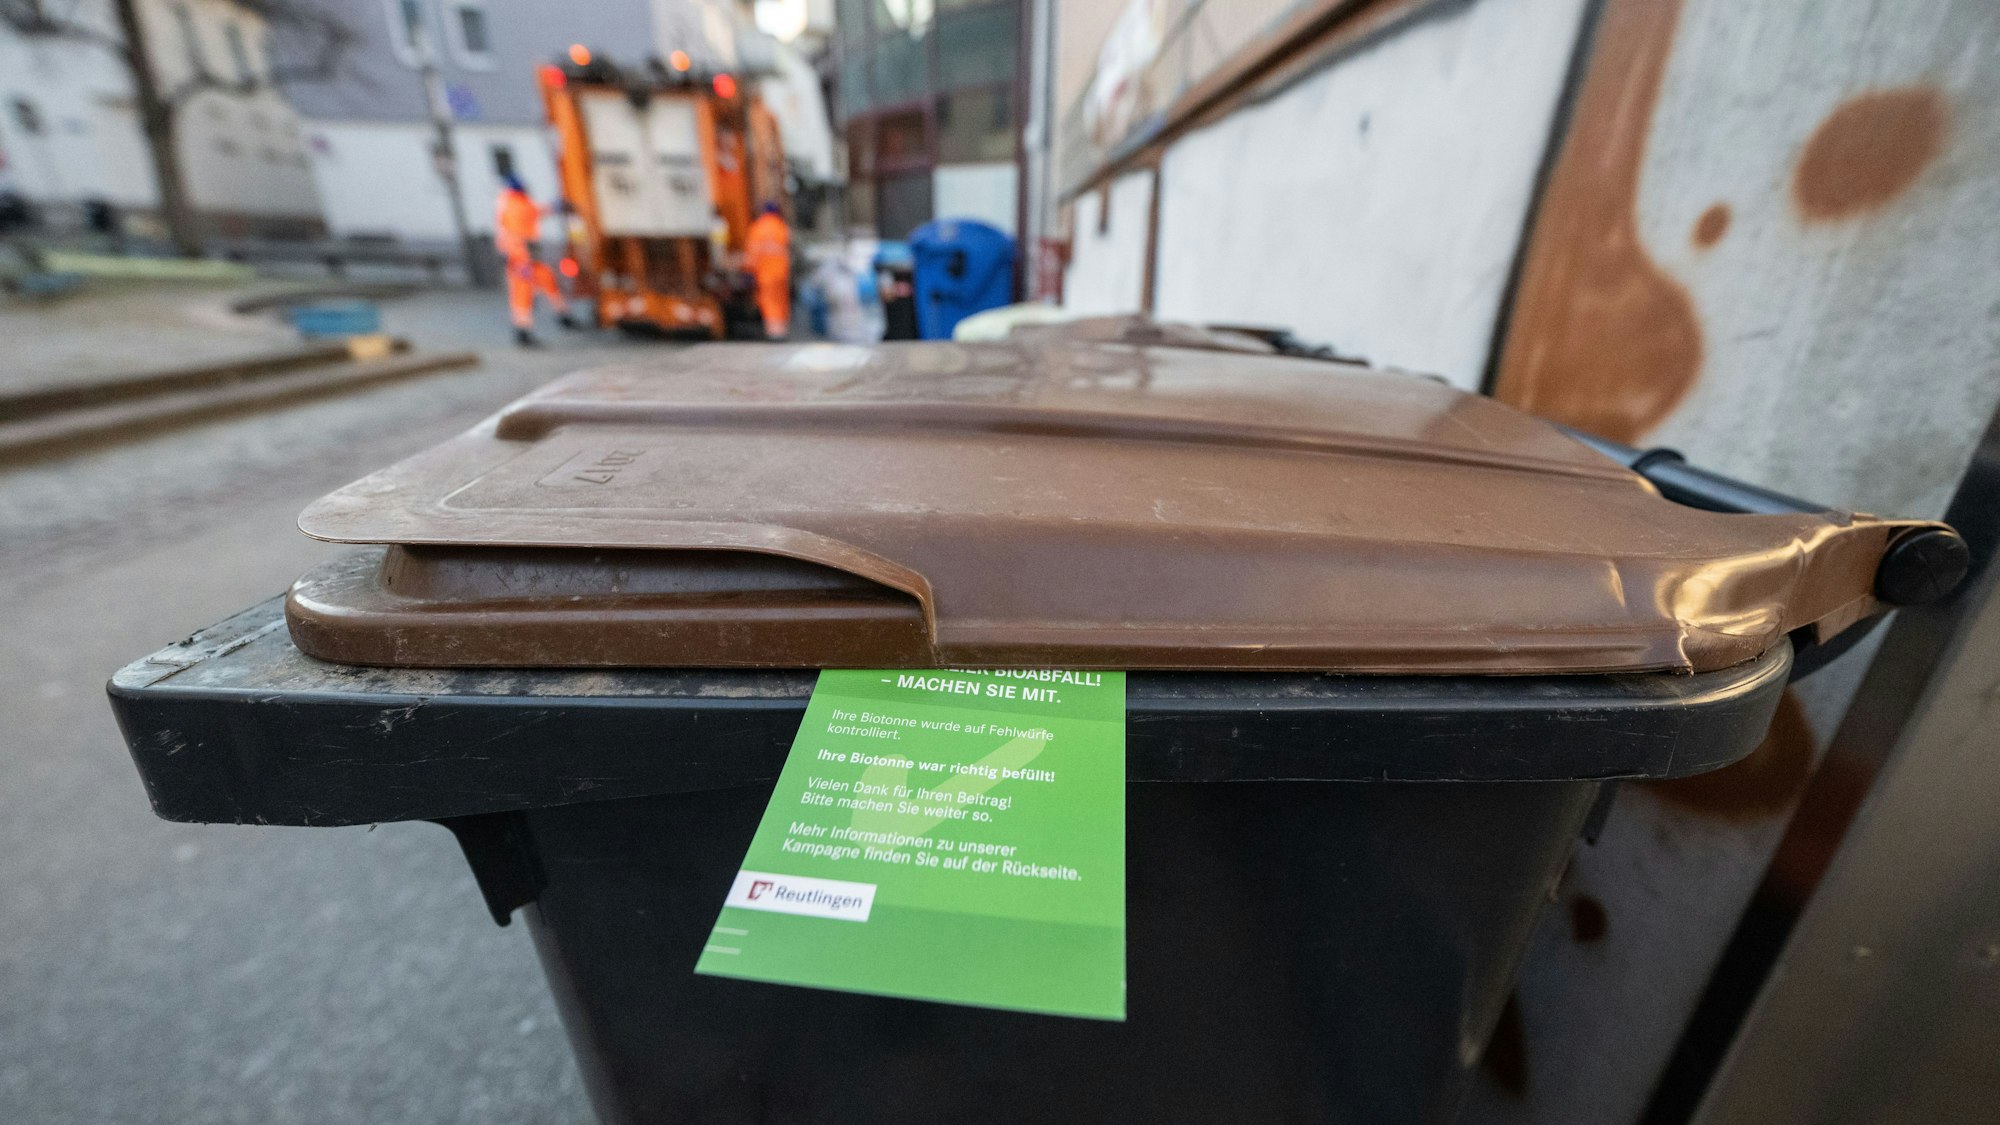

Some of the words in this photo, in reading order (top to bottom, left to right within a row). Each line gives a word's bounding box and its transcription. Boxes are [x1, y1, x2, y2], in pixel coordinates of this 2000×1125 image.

[896, 674, 981, 696] MACHEN
[985, 683, 1017, 700] SIE
[1021, 686, 1062, 704] MIT.
[826, 722, 901, 741] kontrolliert.
[831, 708, 857, 722] Ihre
[859, 711, 918, 728] Biotonne
[920, 719, 961, 732] wurde
[963, 723, 987, 735] auf
[989, 724, 1055, 742] Fehlwürfe
[816, 748, 847, 763] Ihre
[849, 751, 915, 770] Biotonne
[917, 760, 947, 773] war
[949, 761, 999, 781] richtig
[1001, 766, 1056, 783] befüllt!
[800, 791, 834, 806] Bitte
[836, 797, 893, 813] machen
[896, 800, 920, 815] Sie
[923, 805, 969, 820] weiter
[971, 810, 994, 823] so.
[807, 776, 850, 792] Vielen
[852, 781, 889, 796] Dank
[892, 784, 913, 799] für
[915, 787, 953, 803] Ihren
[956, 790, 1012, 811] Beitrag!
[788, 820, 828, 837] Mehr
[830, 826, 933, 849] Informationen
[936, 838, 955, 851] zu
[958, 841, 1018, 857] unserer
[781, 837, 860, 860] Kampagne
[862, 847, 911, 865] finden
[914, 851, 940, 868] Sie
[942, 855, 969, 871] auf
[971, 857, 998, 873] der
[1001, 859, 1083, 882] Rückseite.
[775, 885, 863, 910] Reutlingen
